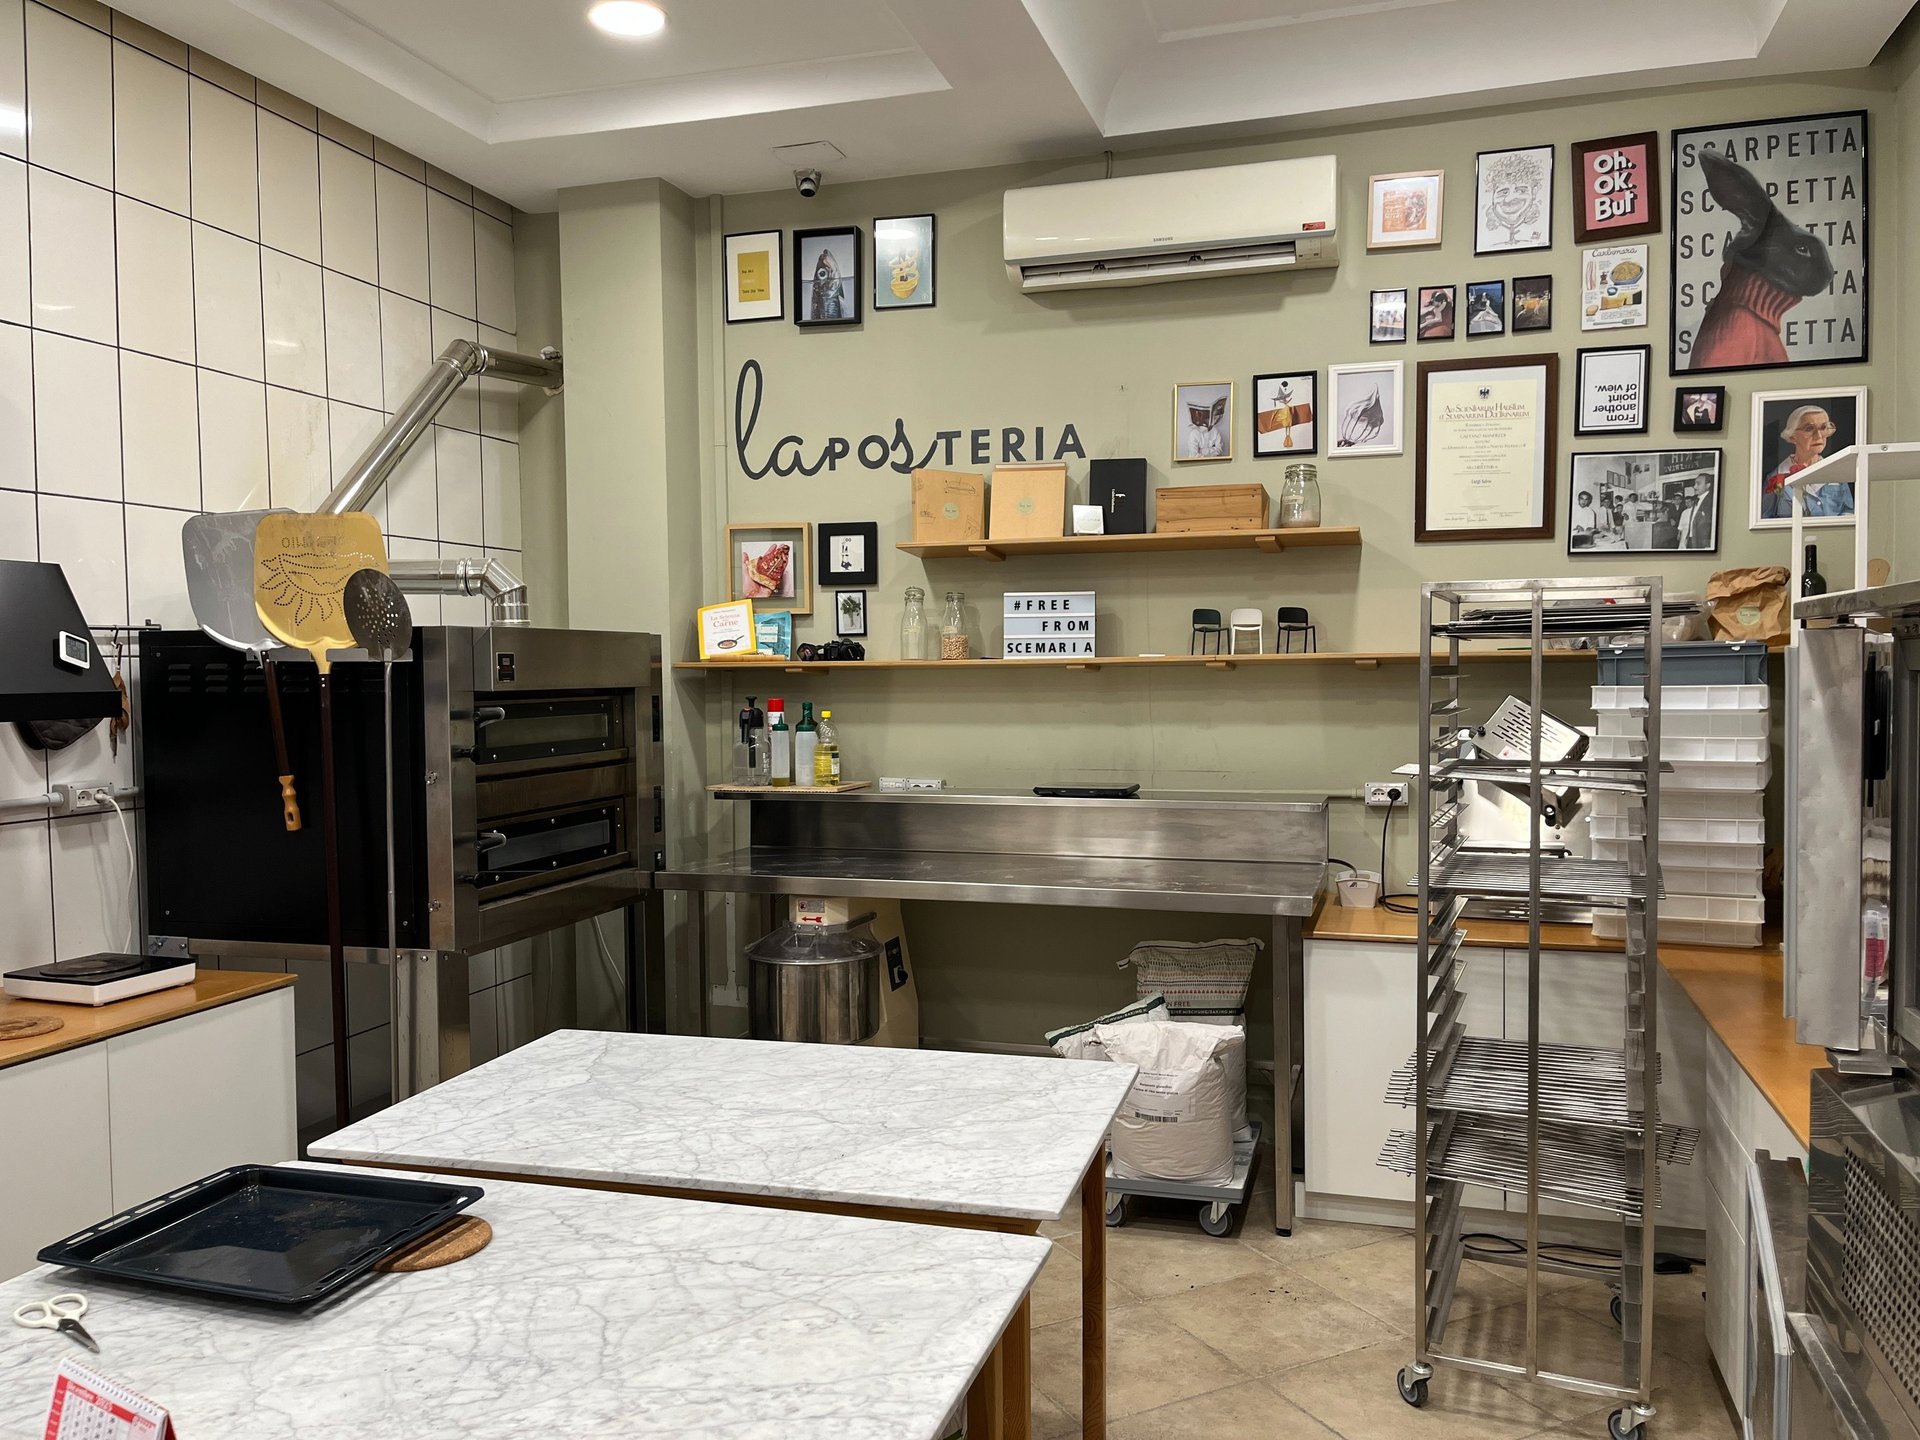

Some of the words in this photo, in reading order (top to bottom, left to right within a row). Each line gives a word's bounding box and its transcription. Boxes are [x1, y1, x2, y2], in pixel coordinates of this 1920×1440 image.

[1682, 127, 1857, 168] SARPETTA
[1593, 151, 1637, 174] Oh.
[1680, 175, 1856, 215] SCPETTA
[1595, 190, 1638, 222] But
[1592, 247, 1638, 257] Carbonara
[1678, 317, 1856, 355] SETTA
[1594, 384, 1623, 393] view.
[1626, 383, 1637, 393] of
[1608, 392, 1637, 403] point
[1593, 403, 1637, 414] another
[1606, 413, 1636, 423] From
[1013, 600, 1070, 611] #FREE
[713, 620, 739, 628] Carne
[1042, 620, 1090, 632] FROM
[1007, 642, 1093, 654] SCEMARIA
